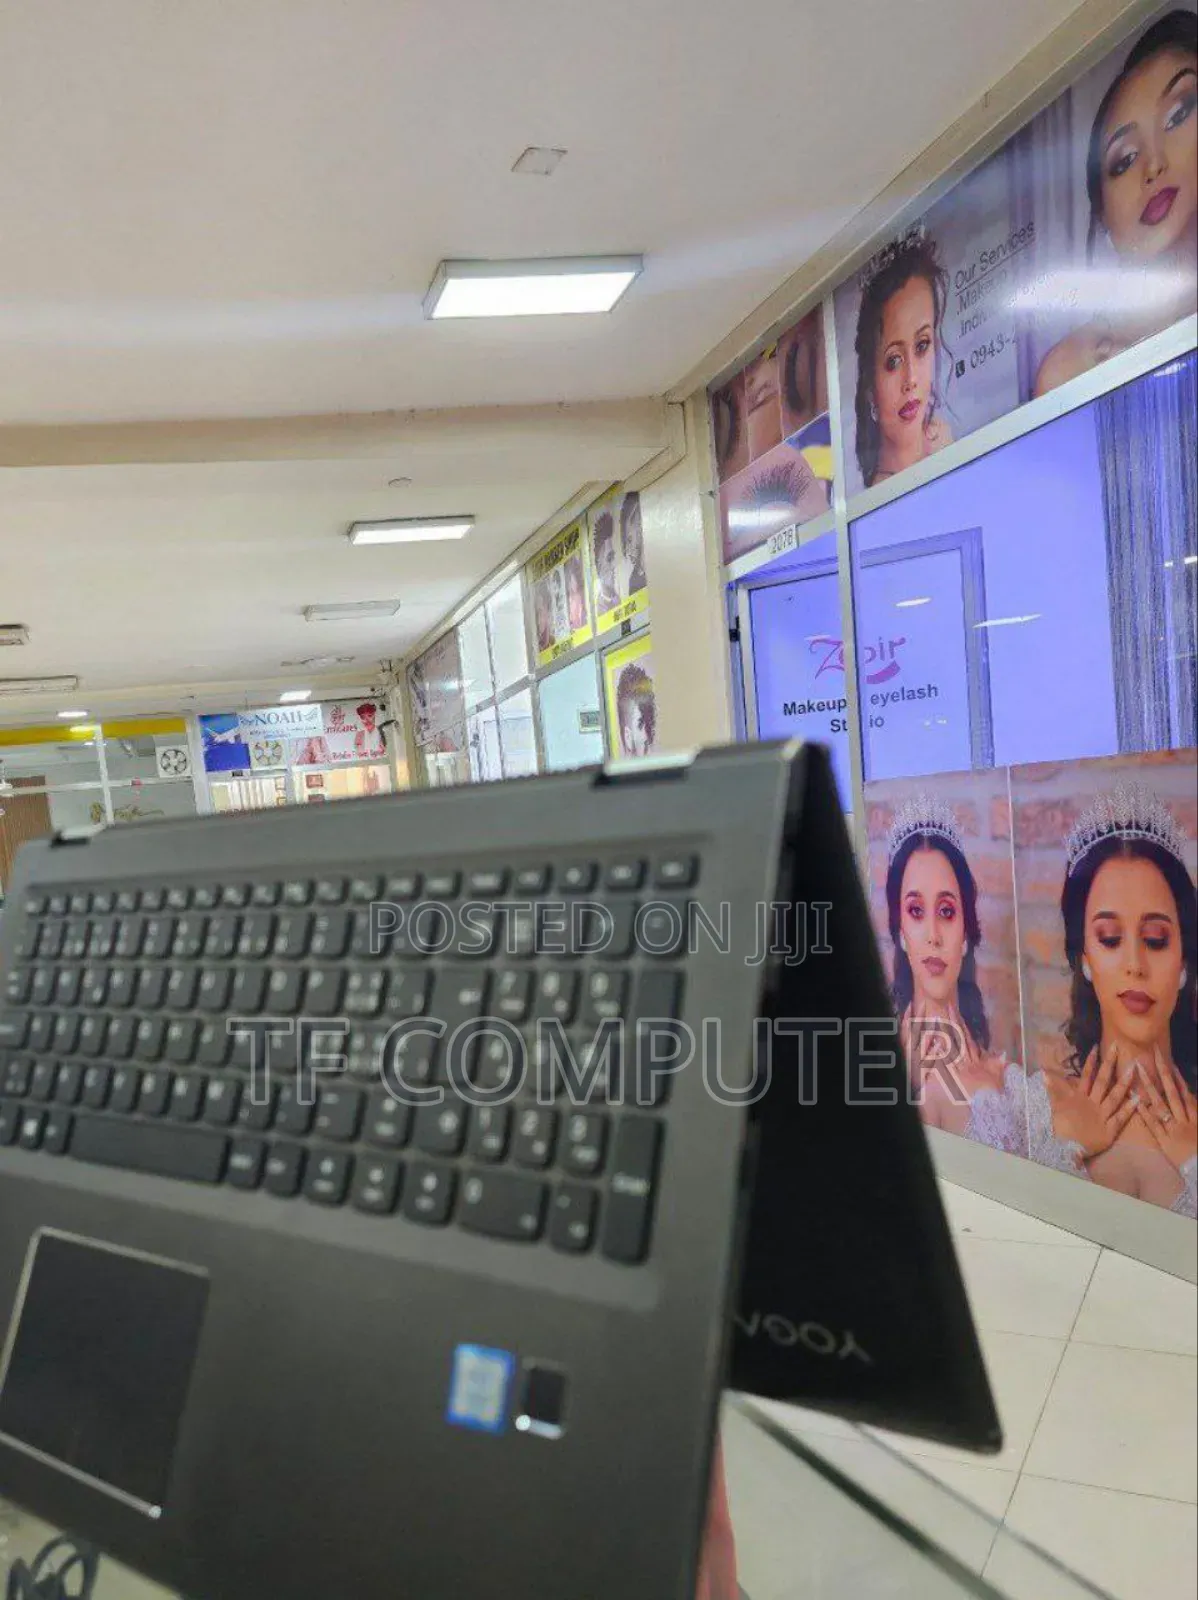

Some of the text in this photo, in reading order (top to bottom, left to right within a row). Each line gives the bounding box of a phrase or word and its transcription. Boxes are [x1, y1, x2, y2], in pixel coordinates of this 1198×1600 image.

[954, 264, 976, 290] Our
[980, 221, 1035, 271] Services
[783, 684, 938, 716] Makeup eyelash
[830, 714, 885, 733] Stio
